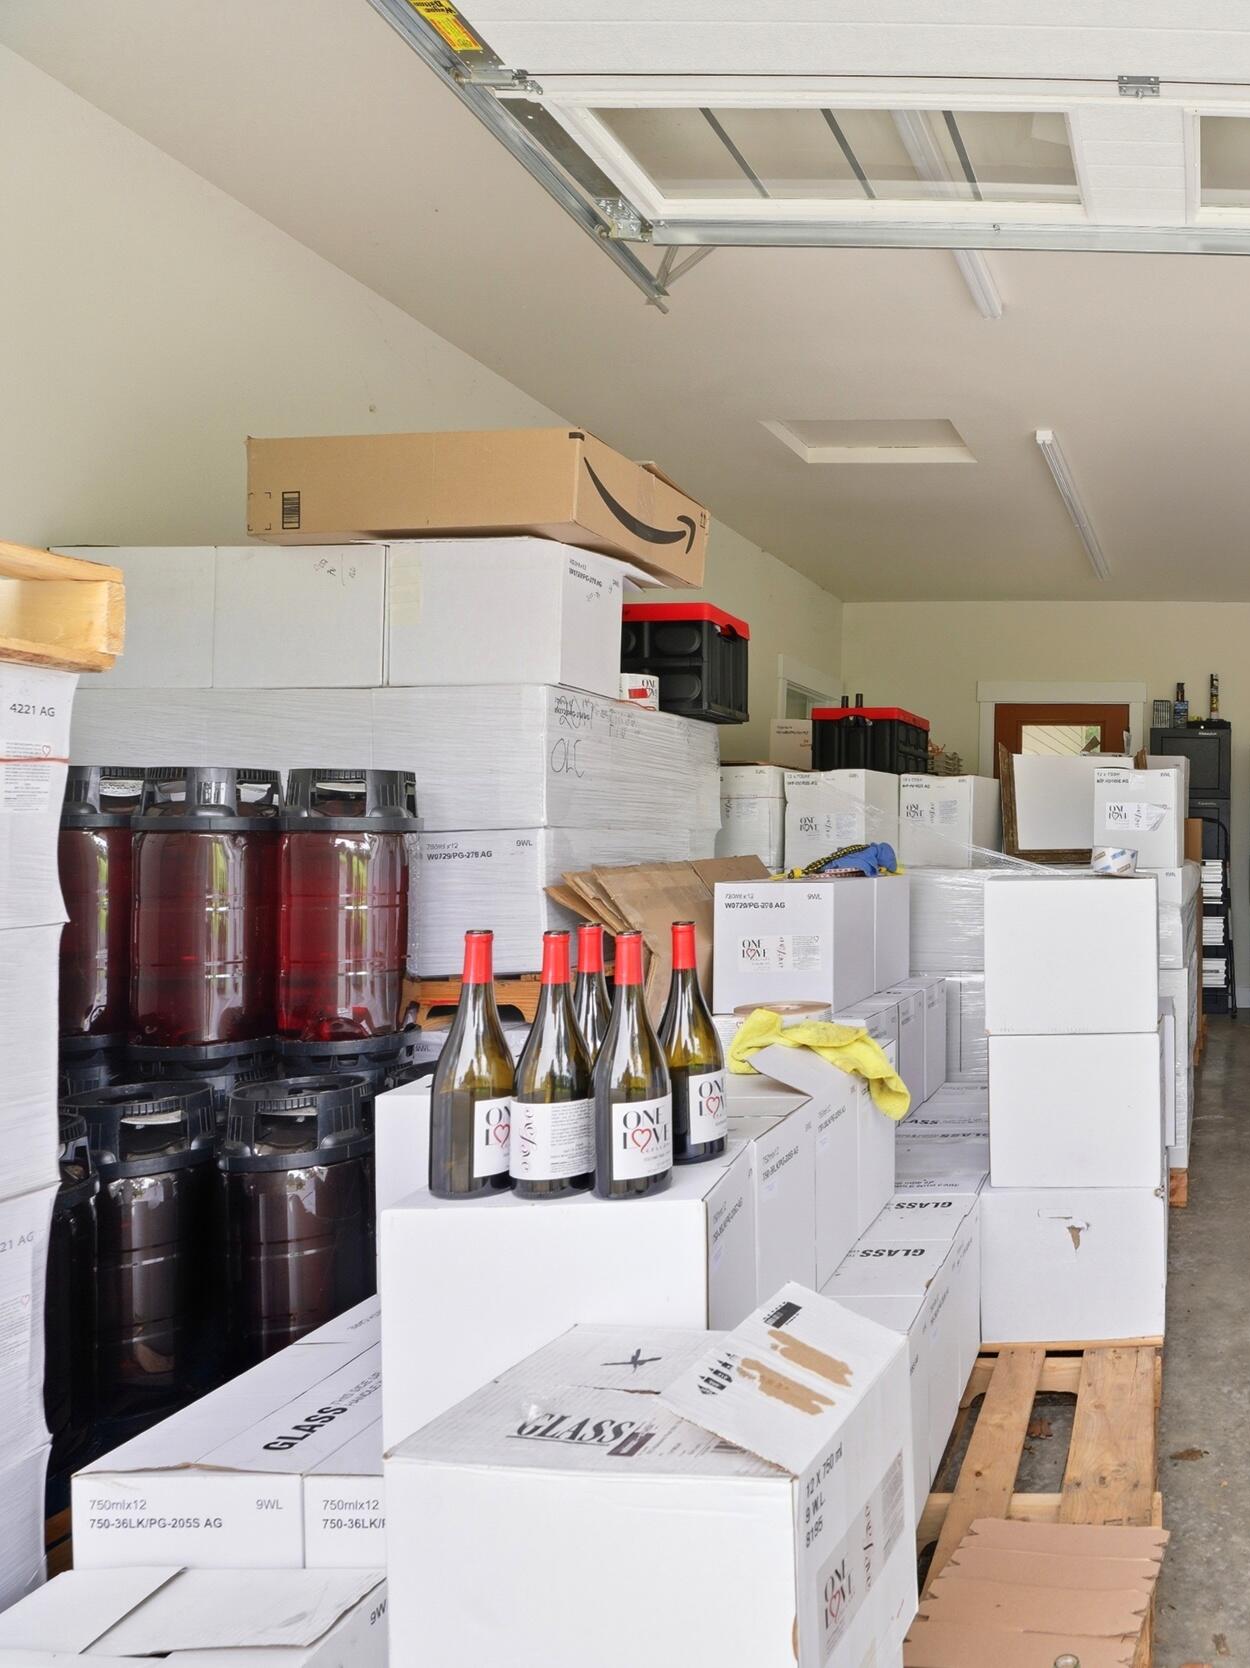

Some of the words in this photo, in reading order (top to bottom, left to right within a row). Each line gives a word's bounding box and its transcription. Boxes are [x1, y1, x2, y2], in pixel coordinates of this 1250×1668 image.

[9, 703, 36, 715] 4221
[40, 706, 55, 717] AG
[894, 1200, 953, 1210] GLASS
[17, 1231, 35, 1247] AG
[859, 1249, 926, 1258] GLASS
[262, 1406, 349, 1451] GLASS
[516, 1413, 635, 1443] GLASS
[256, 1499, 283, 1510] 9WL
[204, 1518, 223, 1529] AG
[369, 1600, 387, 1626] 9W
